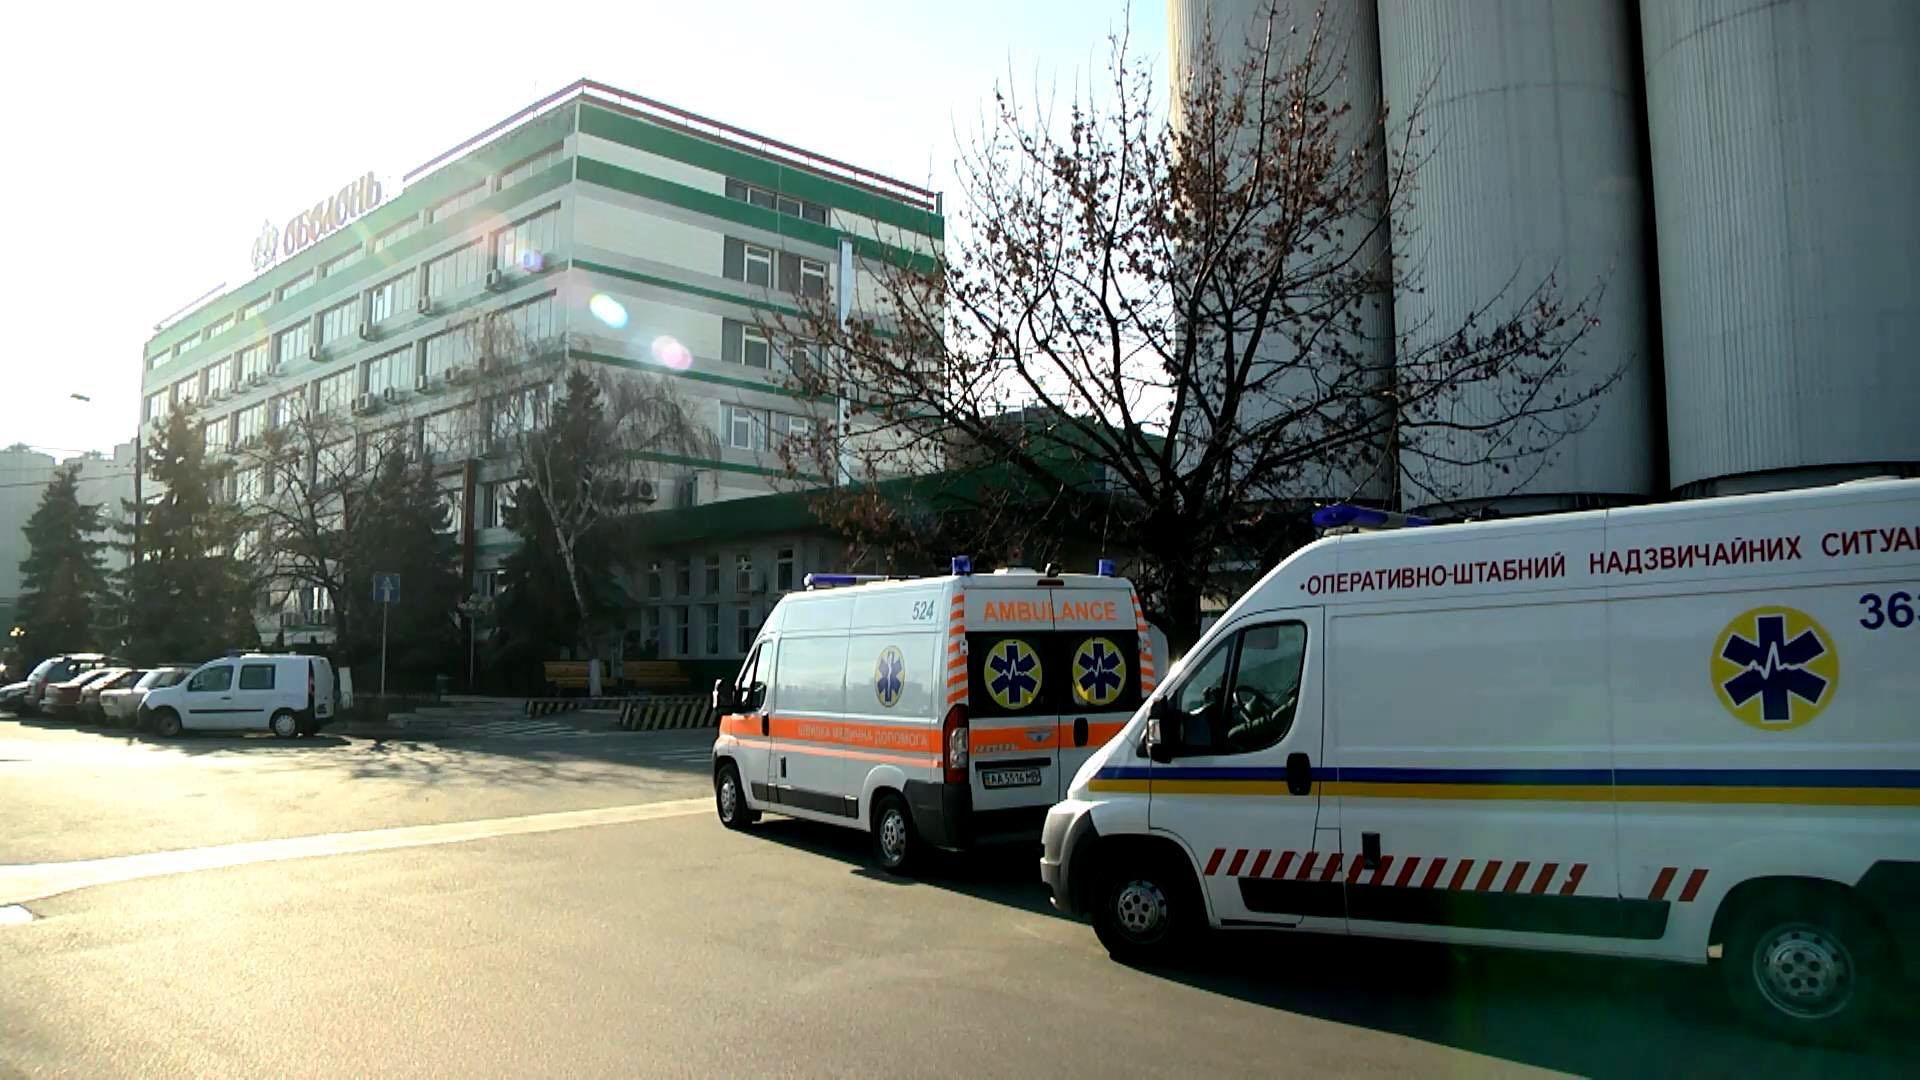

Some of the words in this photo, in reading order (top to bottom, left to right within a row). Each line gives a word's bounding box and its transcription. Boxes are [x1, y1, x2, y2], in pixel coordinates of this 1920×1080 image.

[1306, 552, 1566, 596] ОПЕРАТИВНО-ШТАБНИЙ
[1589, 536, 1802, 576] НАДЗВИЧАЙНИХ
[912, 600, 934, 621] 524
[983, 600, 1119, 622] AMBULANCE
[1859, 591, 1920, 630] 36
